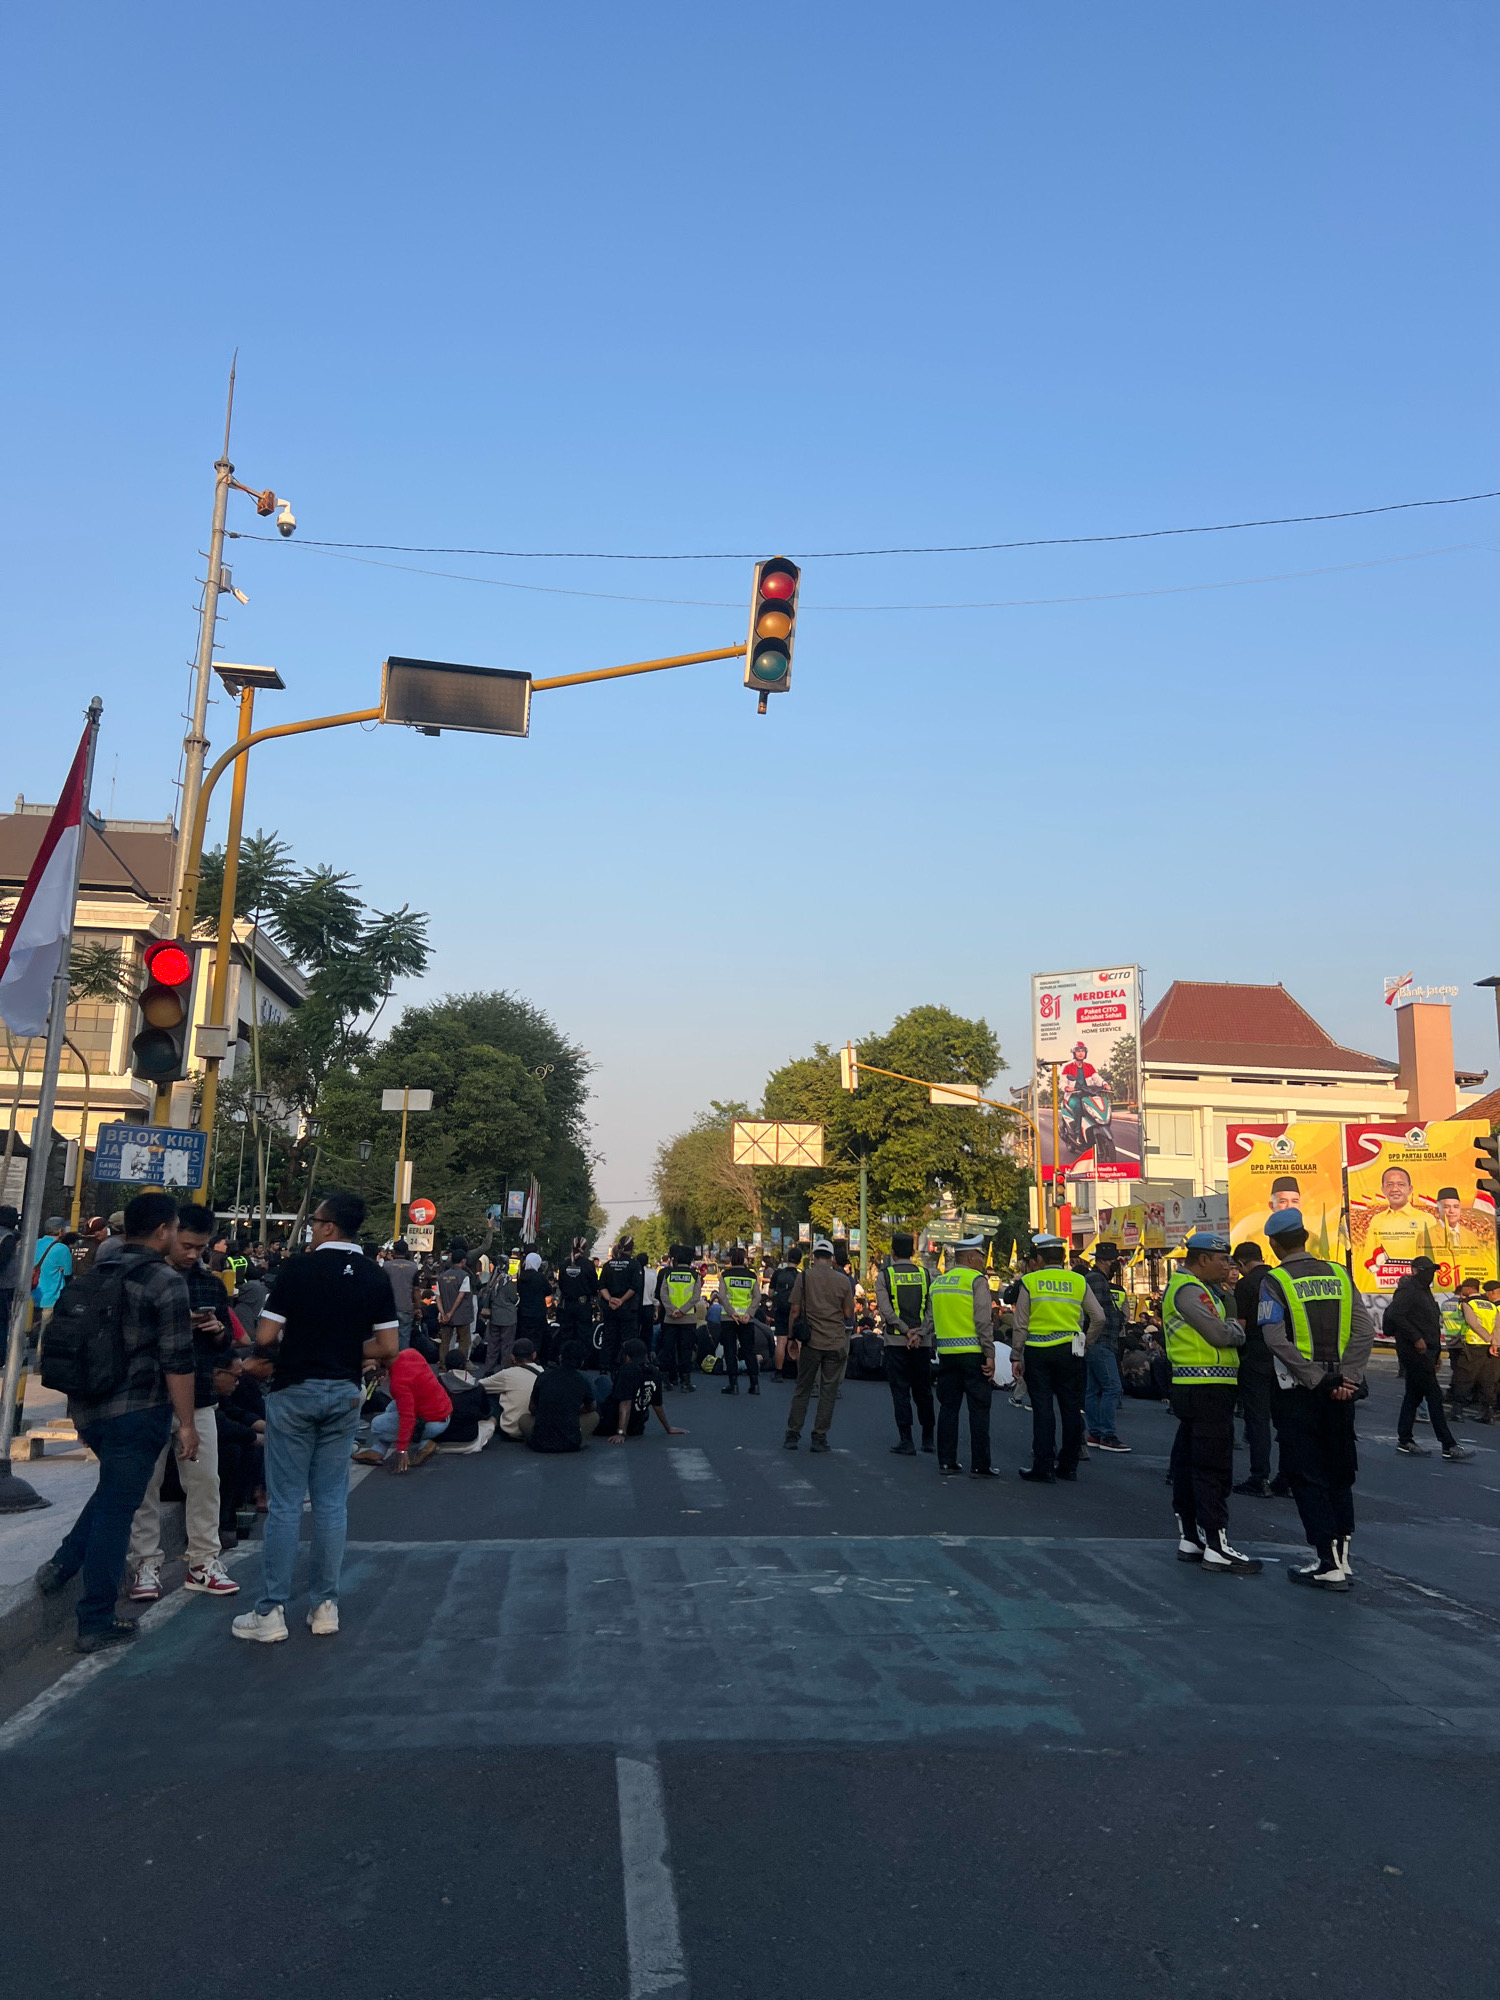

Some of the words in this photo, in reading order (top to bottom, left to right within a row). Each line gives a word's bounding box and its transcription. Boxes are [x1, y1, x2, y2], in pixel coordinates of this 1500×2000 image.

[1108, 972, 1130, 980] CITO
[1073, 989, 1126, 1002] MERDEKA
[1400, 986, 1423, 997] Bank
[1040, 994, 1062, 1020] 81
[106, 1129, 160, 1144] BELOK
[166, 1134, 198, 1148] KIRI
[894, 1274, 922, 1284] POLISI
[934, 1275, 960, 1285] POLISI
[1437, 1262, 1461, 1288] 81
[1038, 1280, 1072, 1293] POLISI
